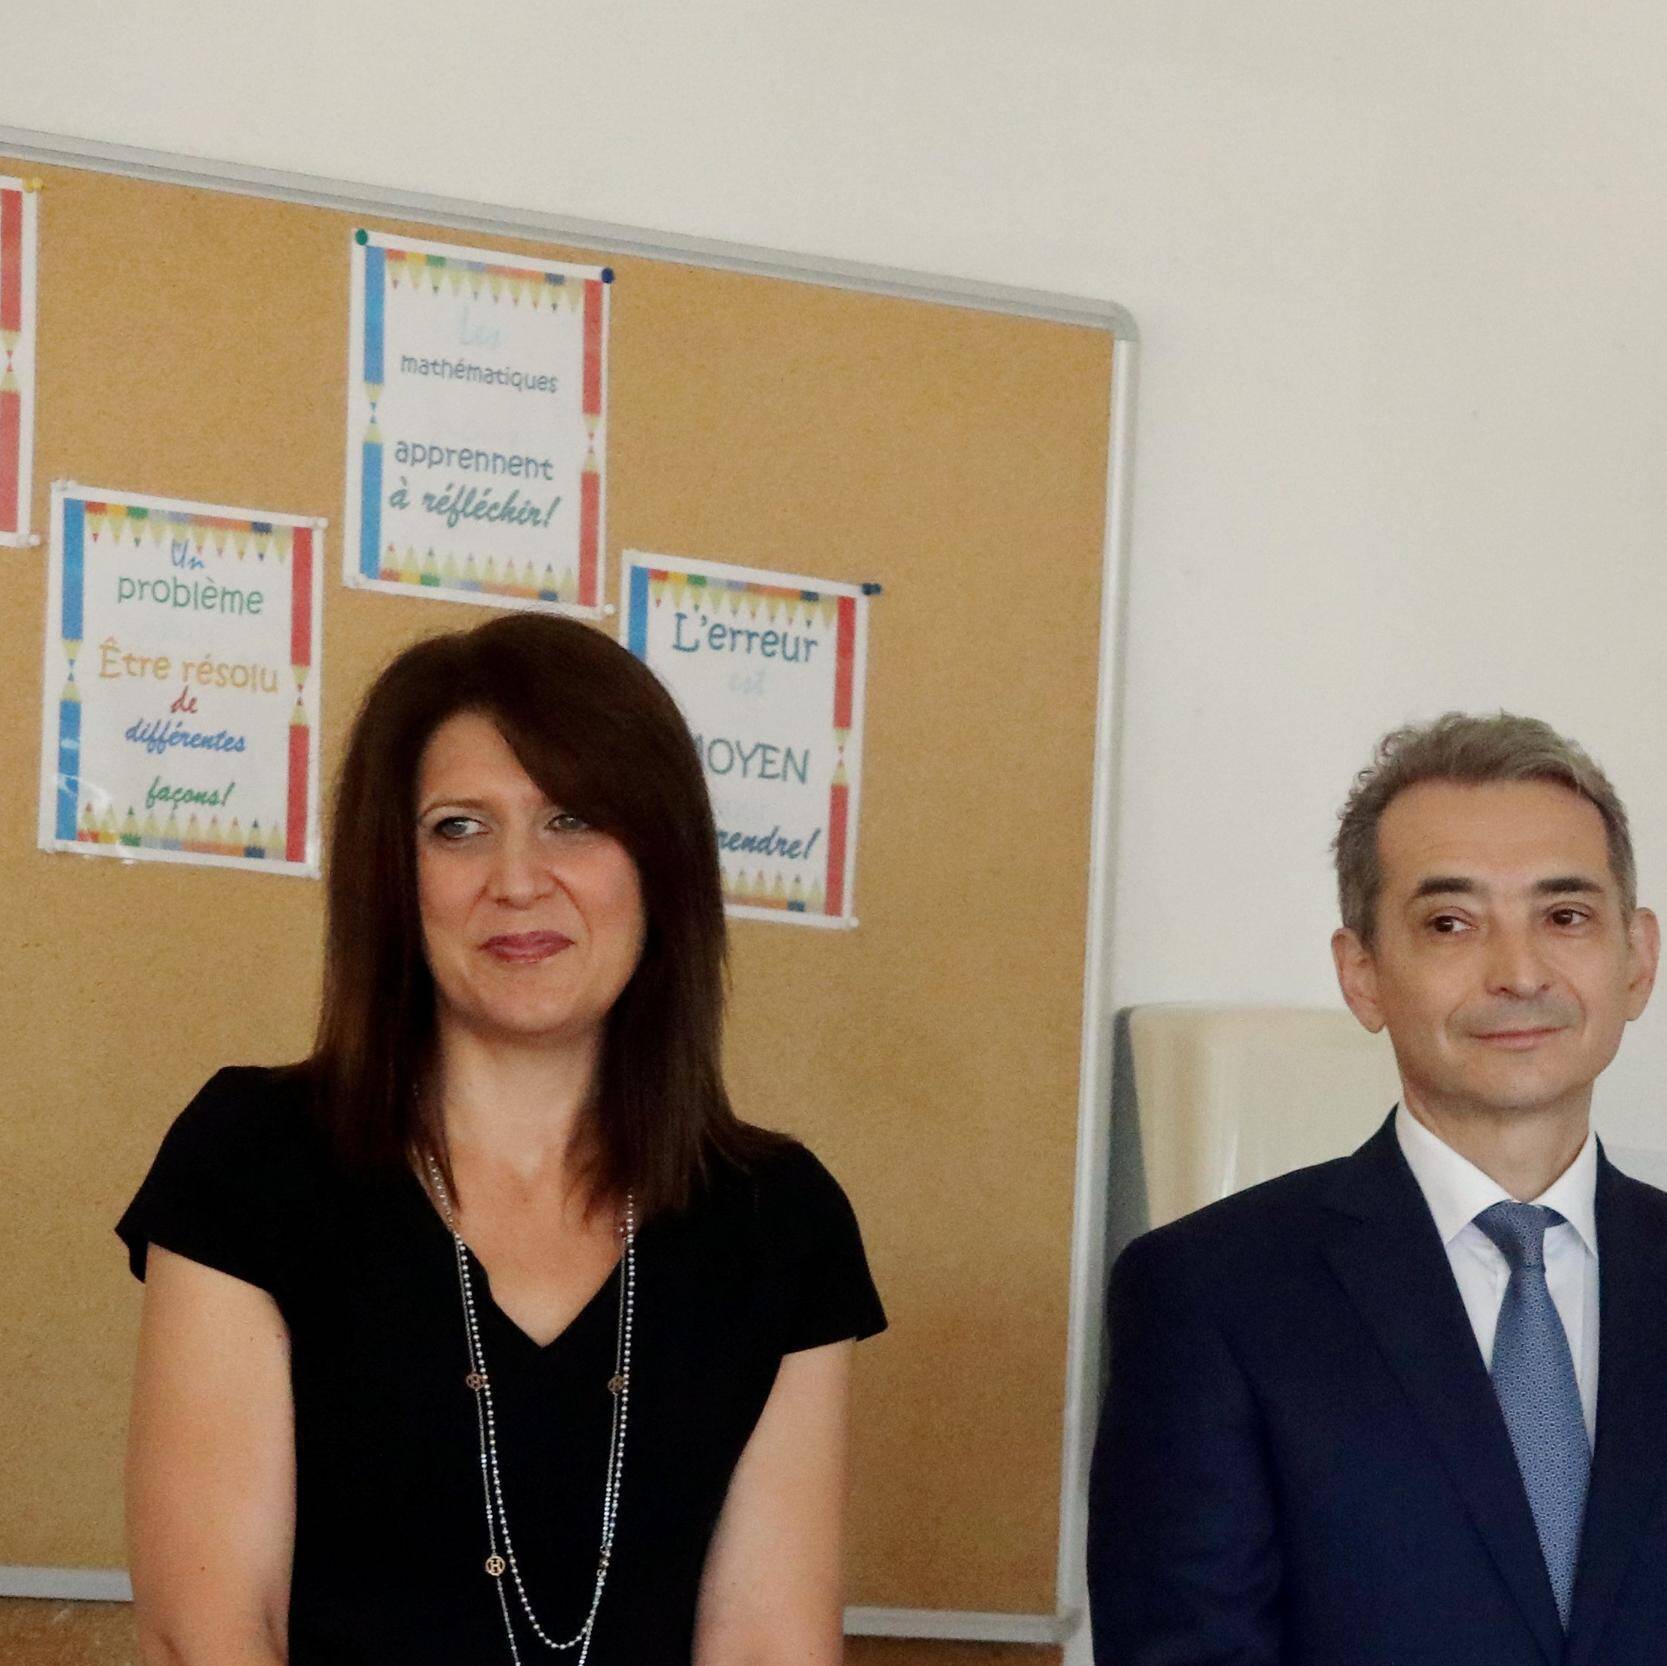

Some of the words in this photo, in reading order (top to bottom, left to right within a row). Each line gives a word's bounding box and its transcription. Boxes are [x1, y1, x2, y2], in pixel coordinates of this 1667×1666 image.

[400, 354, 559, 394] mathématiques
[394, 439, 554, 481] apprennent
[388, 476, 411, 511] à
[421, 482, 563, 529] réfléchir!
[170, 538, 205, 569] Un
[117, 576, 264, 615] problème
[672, 612, 818, 663] L'erreur
[99, 636, 172, 680] Être
[182, 655, 279, 695] résolu
[170, 685, 199, 714] de
[125, 717, 246, 755] différentes
[696, 734, 810, 785] OYEN
[145, 775, 236, 808] façons!
[718, 826, 821, 860] rendre!
